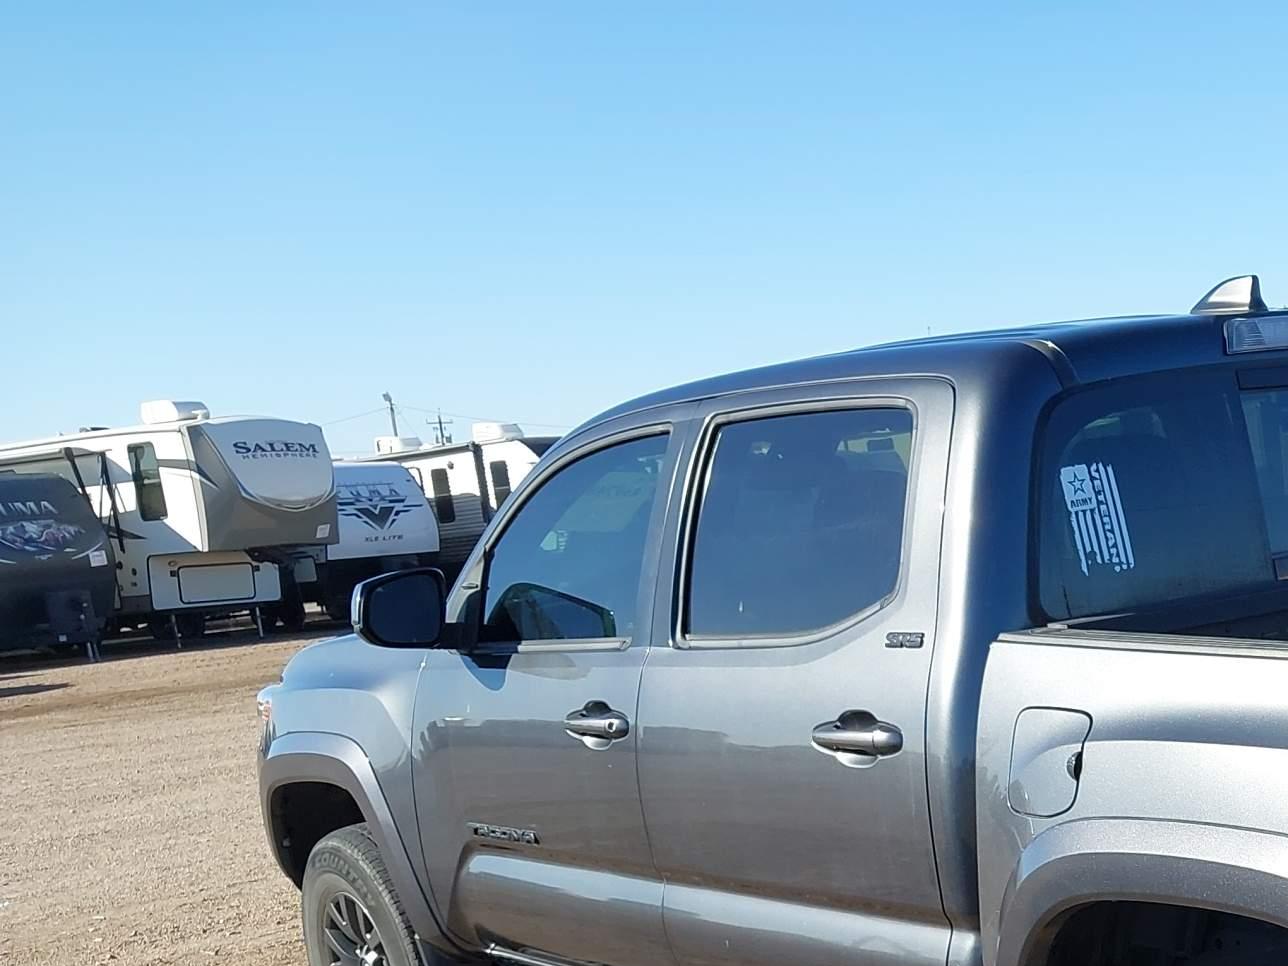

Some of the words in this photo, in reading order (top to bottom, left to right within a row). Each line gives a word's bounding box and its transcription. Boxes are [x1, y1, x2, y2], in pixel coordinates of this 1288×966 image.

[233, 441, 319, 454] SALEM
[0, 501, 58, 516] UMA
[1070, 497, 1093, 509] ARMY
[1090, 462, 1120, 563] VETERAN
[885, 632, 925, 648] SR5
[466, 823, 540, 845] TACOMA
[312, 852, 376, 907] COUNTRY
